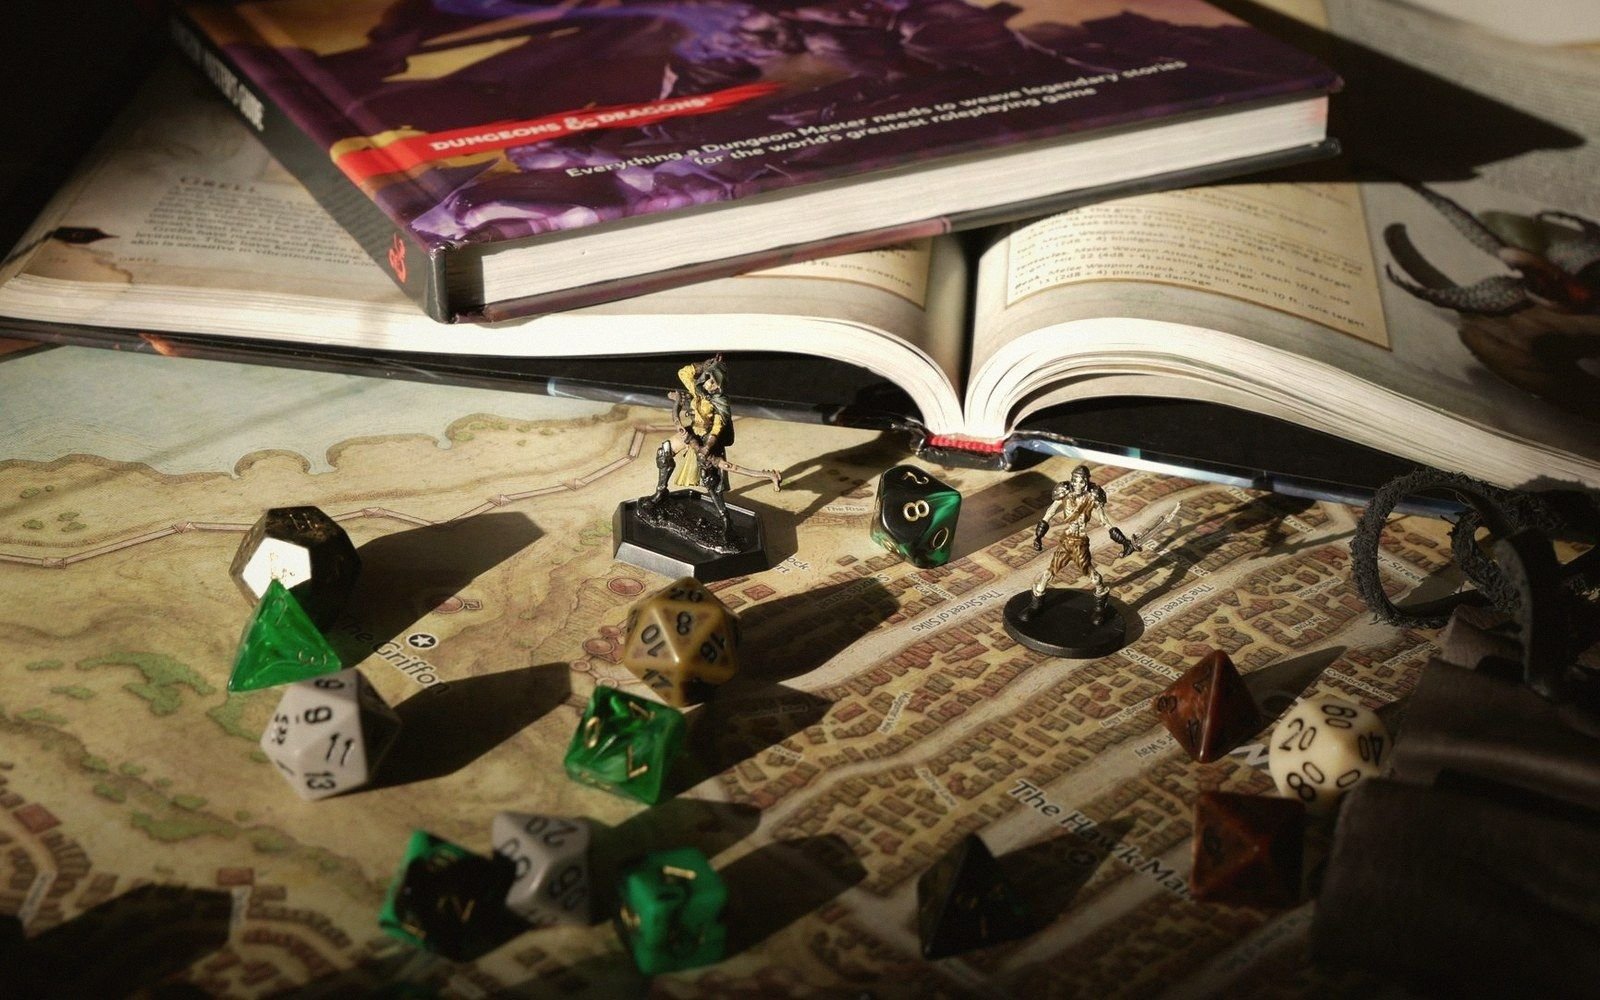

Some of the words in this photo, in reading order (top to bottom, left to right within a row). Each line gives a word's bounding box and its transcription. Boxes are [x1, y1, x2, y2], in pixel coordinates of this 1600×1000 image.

[565, 151, 683, 178] Everything
[686, 149, 699, 157] a
[701, 131, 797, 153] Dungeon
[797, 118, 867, 136] Master
[872, 107, 932, 123] needs
[934, 102, 957, 112] to
[959, 91, 1022, 107] weave
[1021, 73, 1119, 96] legendary
[1121, 60, 1187, 79] stories
[694, 153, 724, 166] for
[730, 147, 765, 160] the
[769, 133, 842, 152] world's
[846, 118, 929, 140] greatest
[931, 98, 1041, 123] roleplaying
[1042, 88, 1097, 104] game
[430, 122, 562, 151] DUNGEONS
[563, 116, 599, 131] &
[902, 499, 931, 522] 8
[932, 527, 950, 551] 0
[978, 589, 1005, 600] The
[1189, 583, 1214, 596] The
[950, 598, 984, 616] Street
[1151, 610, 1162, 620] of
[1161, 593, 1195, 612] Street
[676, 610, 692, 636] 8
[911, 617, 941, 632] Silks
[937, 612, 950, 623] of
[641, 623, 667, 658] 10
[372, 639, 451, 694] Griffon
[1121, 648, 1172, 675] Selduth
[1278, 717, 1318, 752] 20
[325, 732, 354, 768] 11
[1134, 743, 1159, 758] Way
[303, 769, 337, 790] 13
[1286, 761, 1326, 801] 80
[1010, 779, 1060, 817] The
[1060, 810, 1140, 866] Hawk
